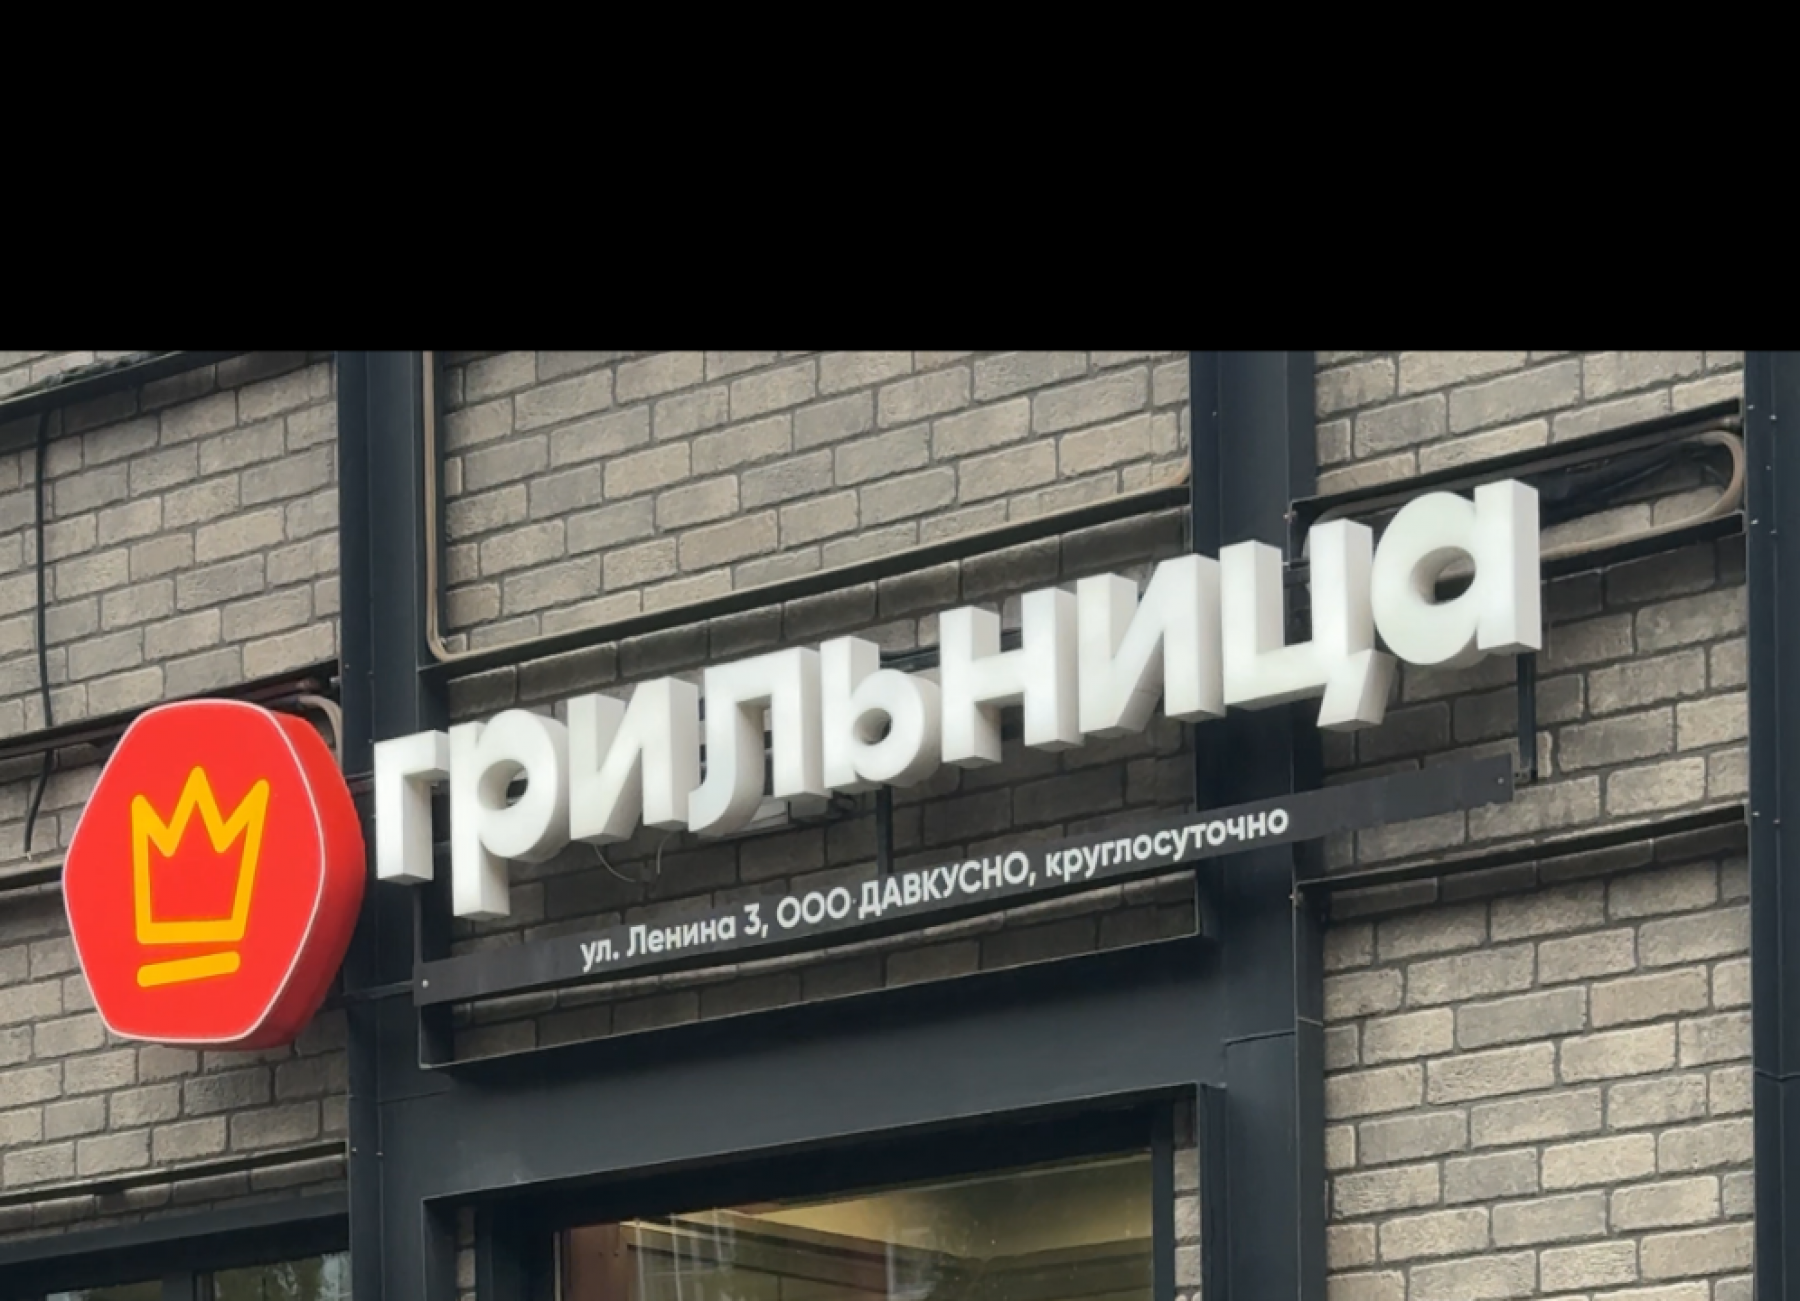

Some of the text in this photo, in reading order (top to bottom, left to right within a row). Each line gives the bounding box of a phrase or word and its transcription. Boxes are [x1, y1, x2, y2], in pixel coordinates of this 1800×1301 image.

[373, 477, 1541, 918] грильница
[580, 807, 1290, 973] ул. Ленина 3, ООО ДАВКУСНО, круглосуточно
